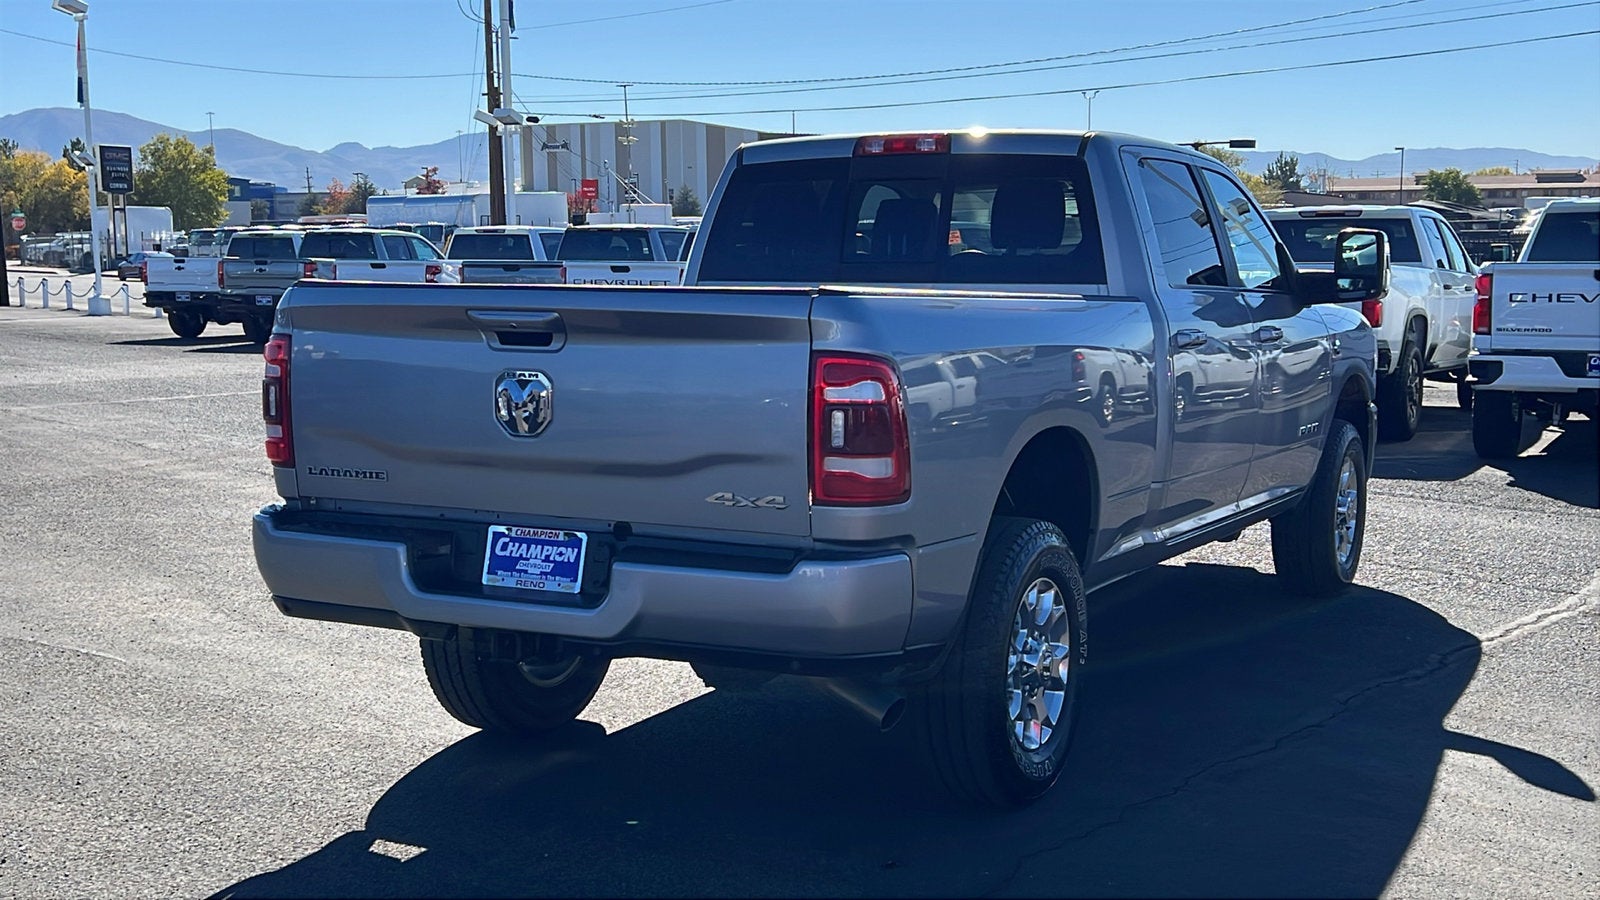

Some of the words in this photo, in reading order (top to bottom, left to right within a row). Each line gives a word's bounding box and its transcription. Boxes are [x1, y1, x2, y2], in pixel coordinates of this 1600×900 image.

[505, 371, 539, 379] RAM
[307, 466, 388, 481] LARAMIE
[515, 528, 560, 540] CHAMPION
[495, 537, 578, 563] CHAMPION
[519, 561, 552, 571] CHEVROLET
[515, 580, 546, 589] RENO
